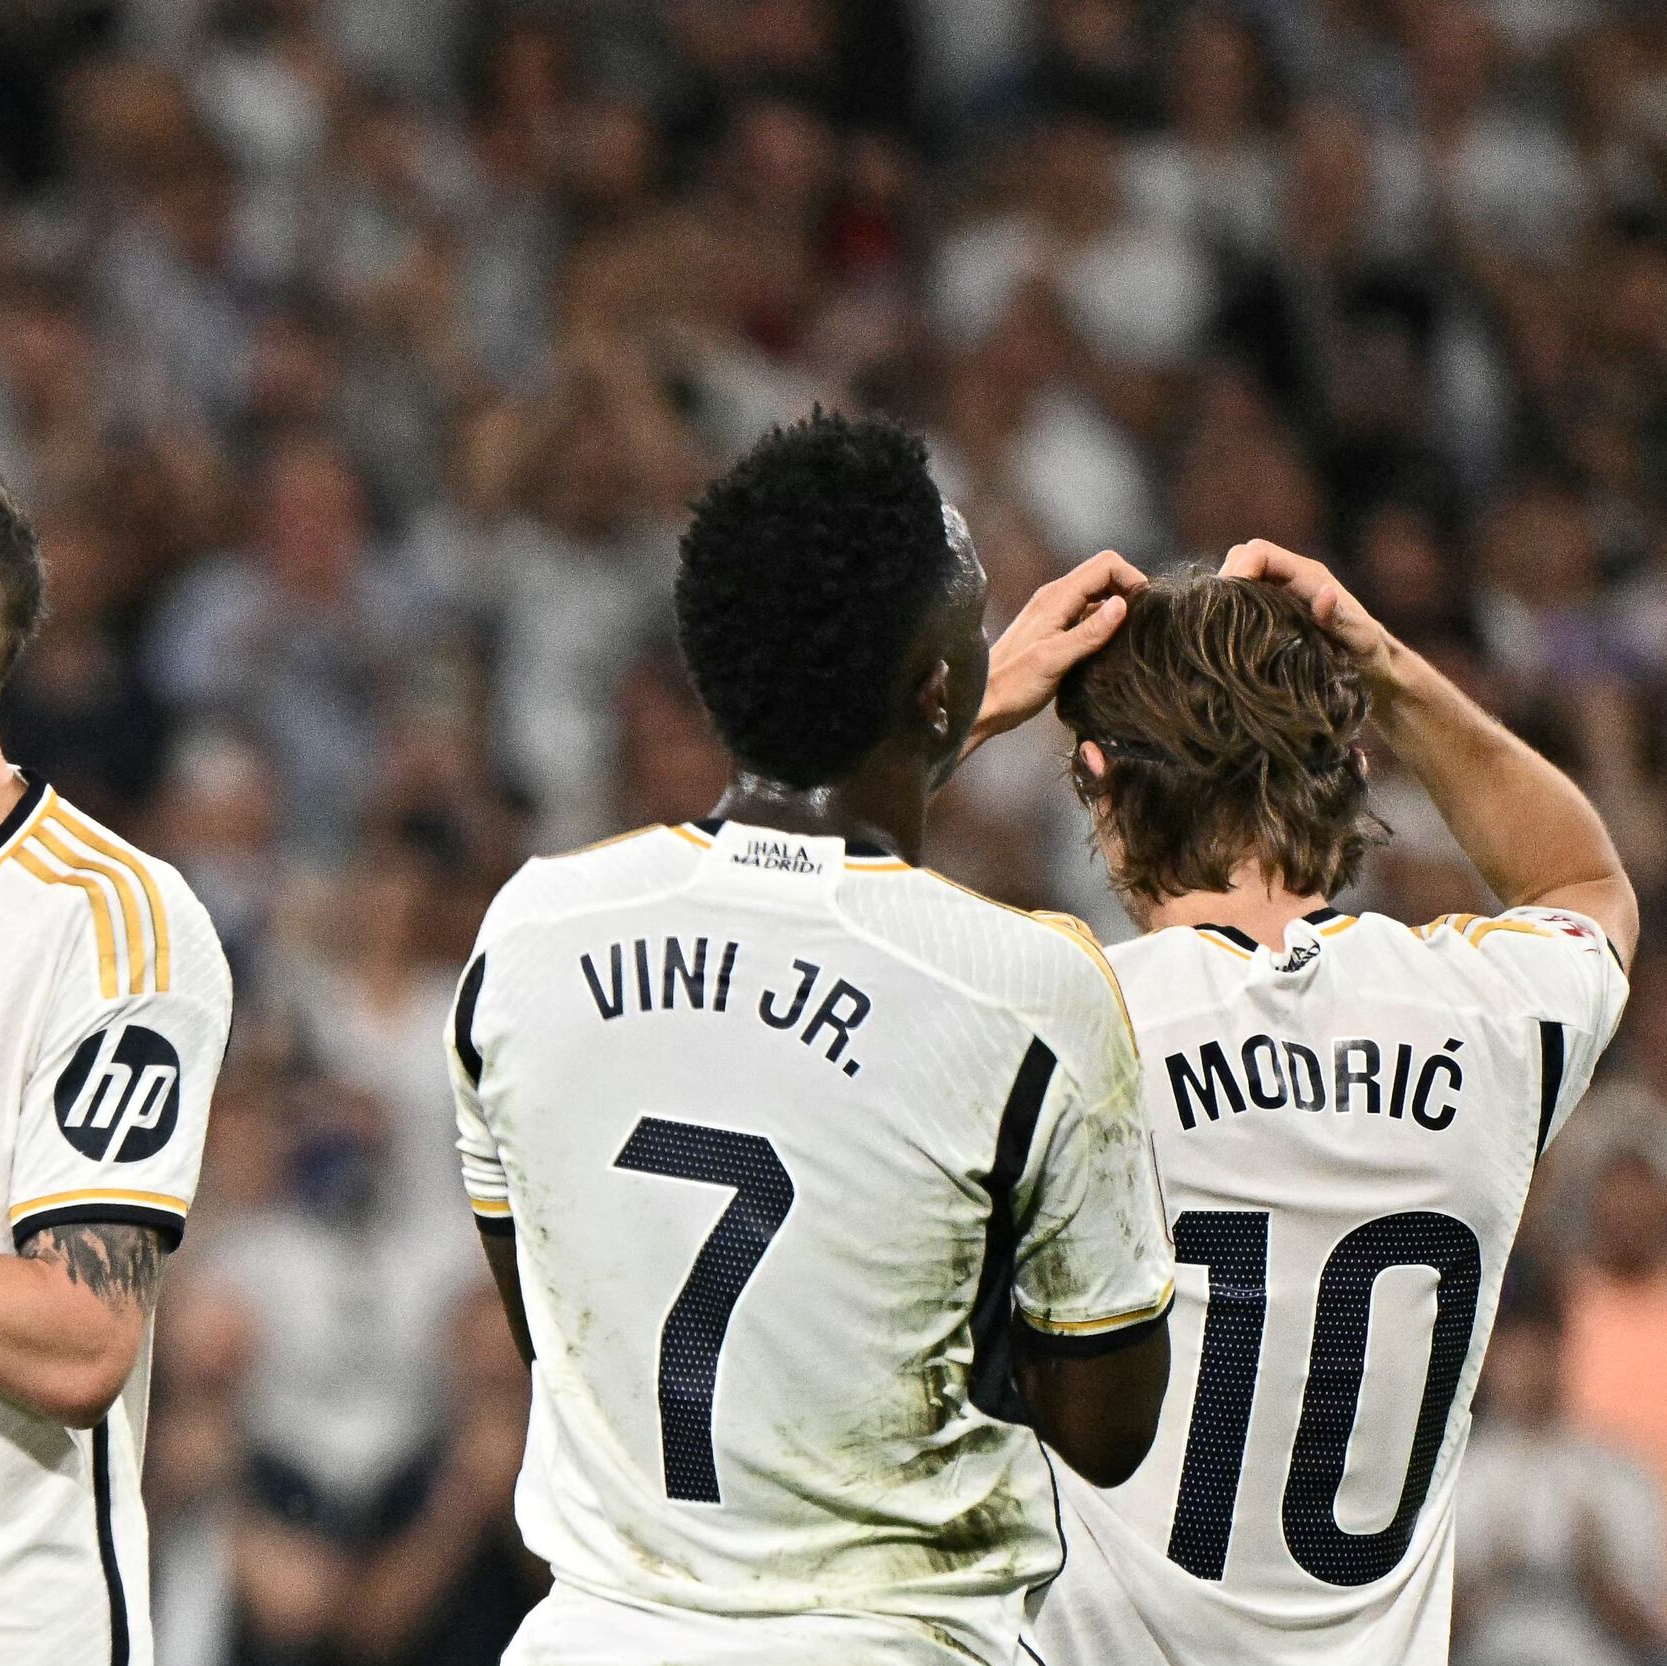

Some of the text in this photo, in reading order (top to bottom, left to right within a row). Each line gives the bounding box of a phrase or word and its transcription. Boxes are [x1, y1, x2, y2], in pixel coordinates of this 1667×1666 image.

[580, 936, 871, 1078] VINI JR.
[63, 1026, 179, 1163] hp
[1165, 1034, 1464, 1131] MODRIĆ
[613, 1116, 795, 1504] 7
[1167, 1211, 1481, 1587] 10
